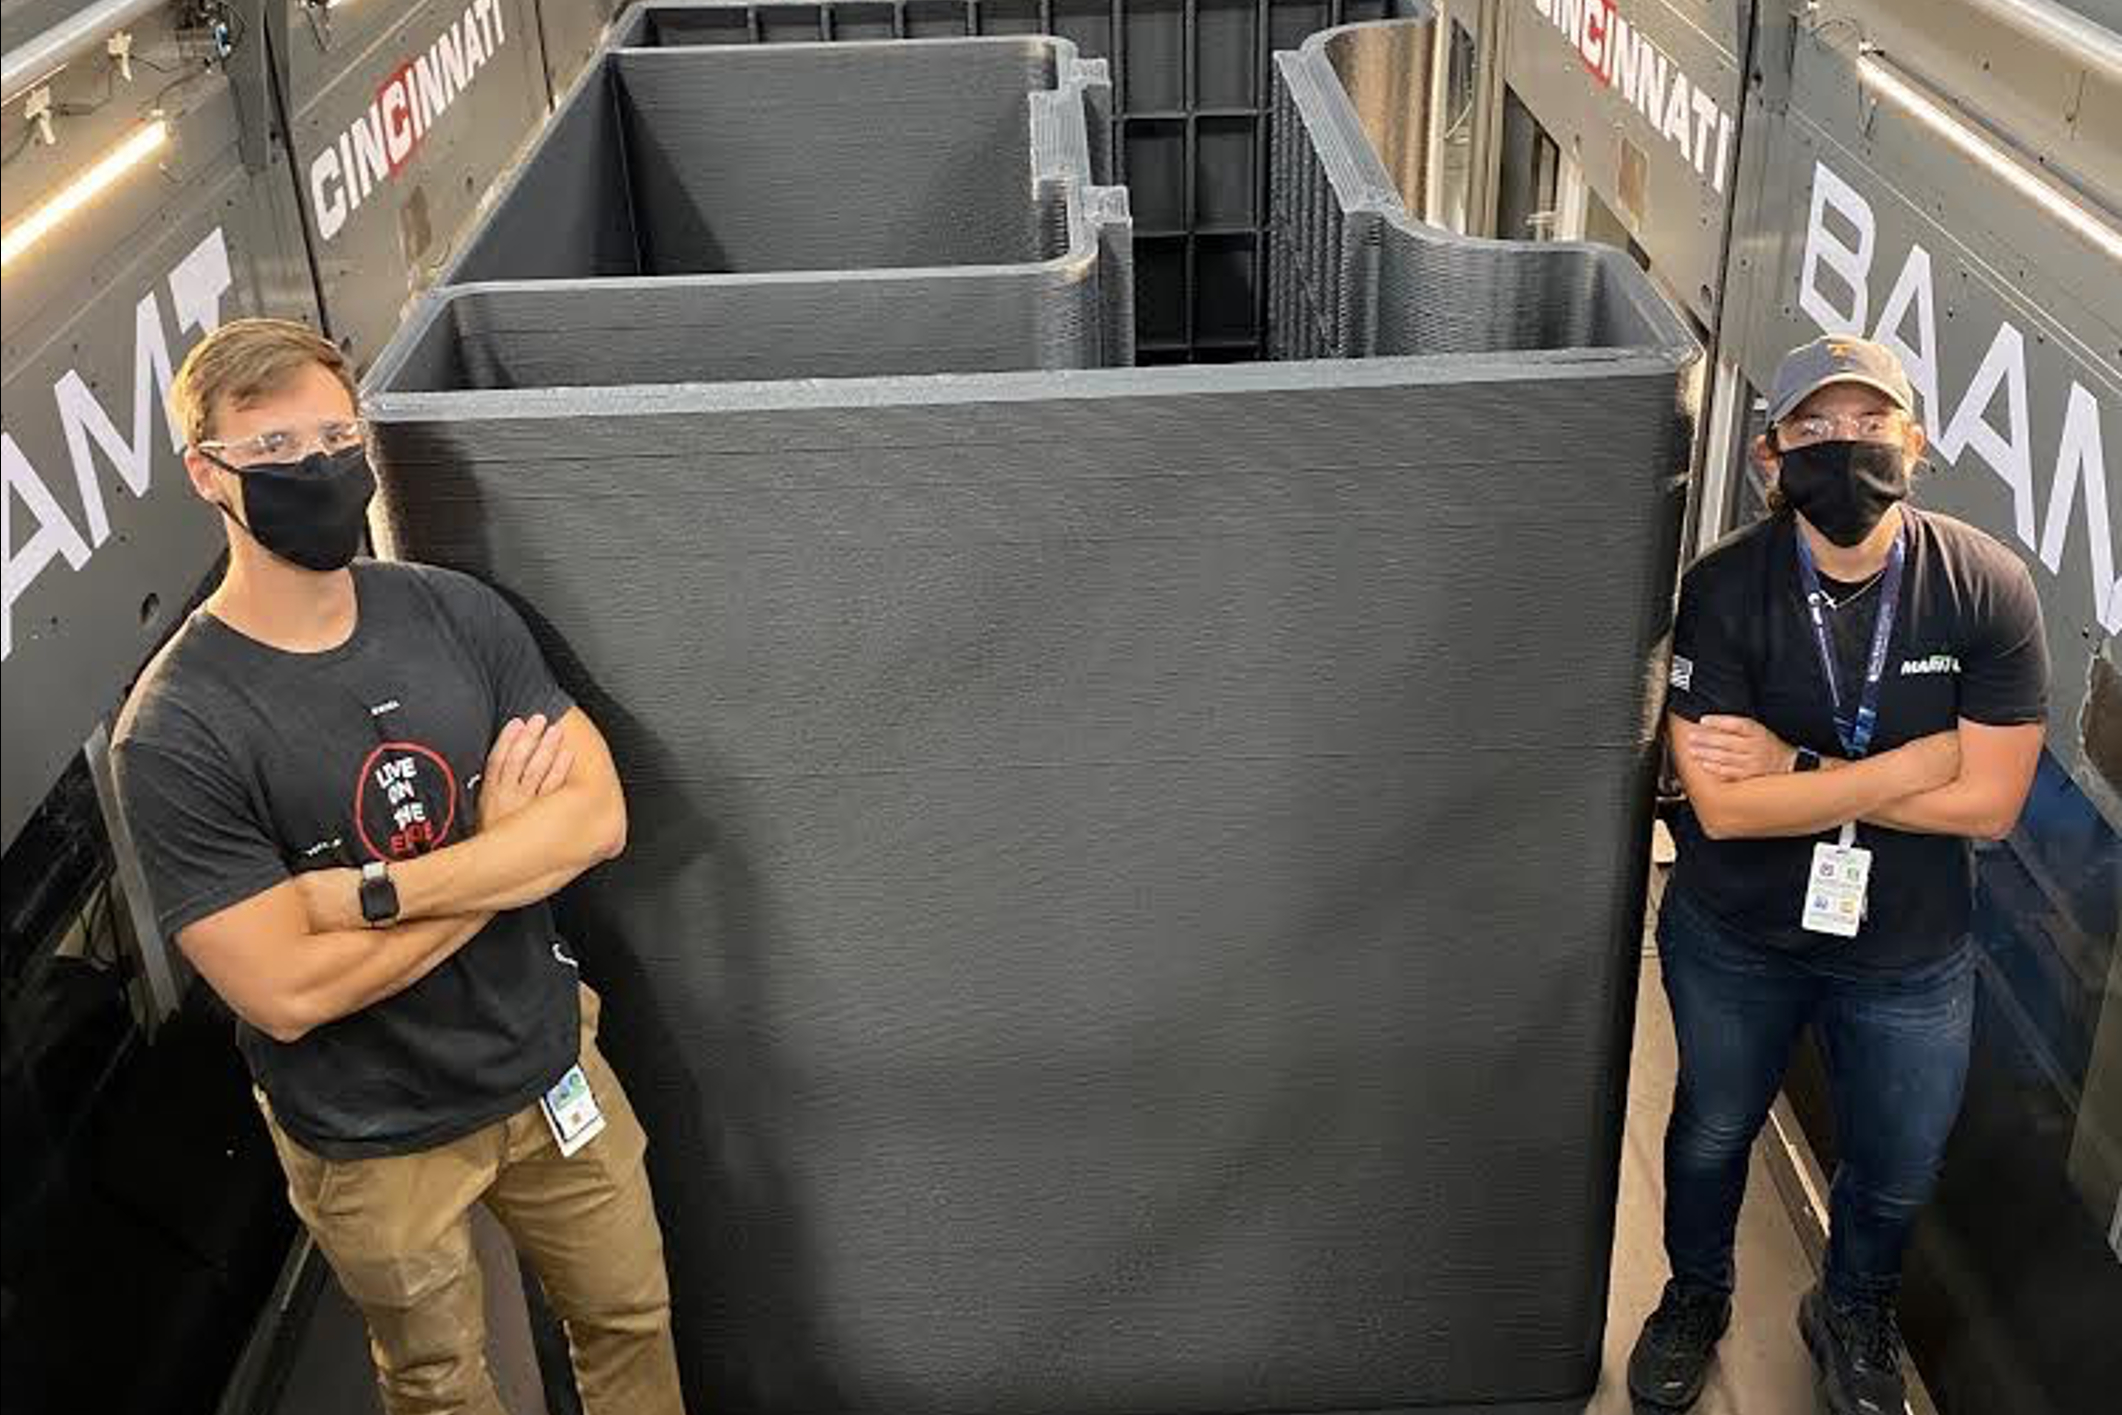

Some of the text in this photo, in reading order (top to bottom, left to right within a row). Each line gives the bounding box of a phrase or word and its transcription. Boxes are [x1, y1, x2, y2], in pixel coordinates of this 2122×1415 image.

[311, 0, 505, 240] CINCINNATI
[1535, 0, 1731, 193] NCINNATI
[375, 757, 417, 789] LIVE
[388, 779, 415, 805] ON
